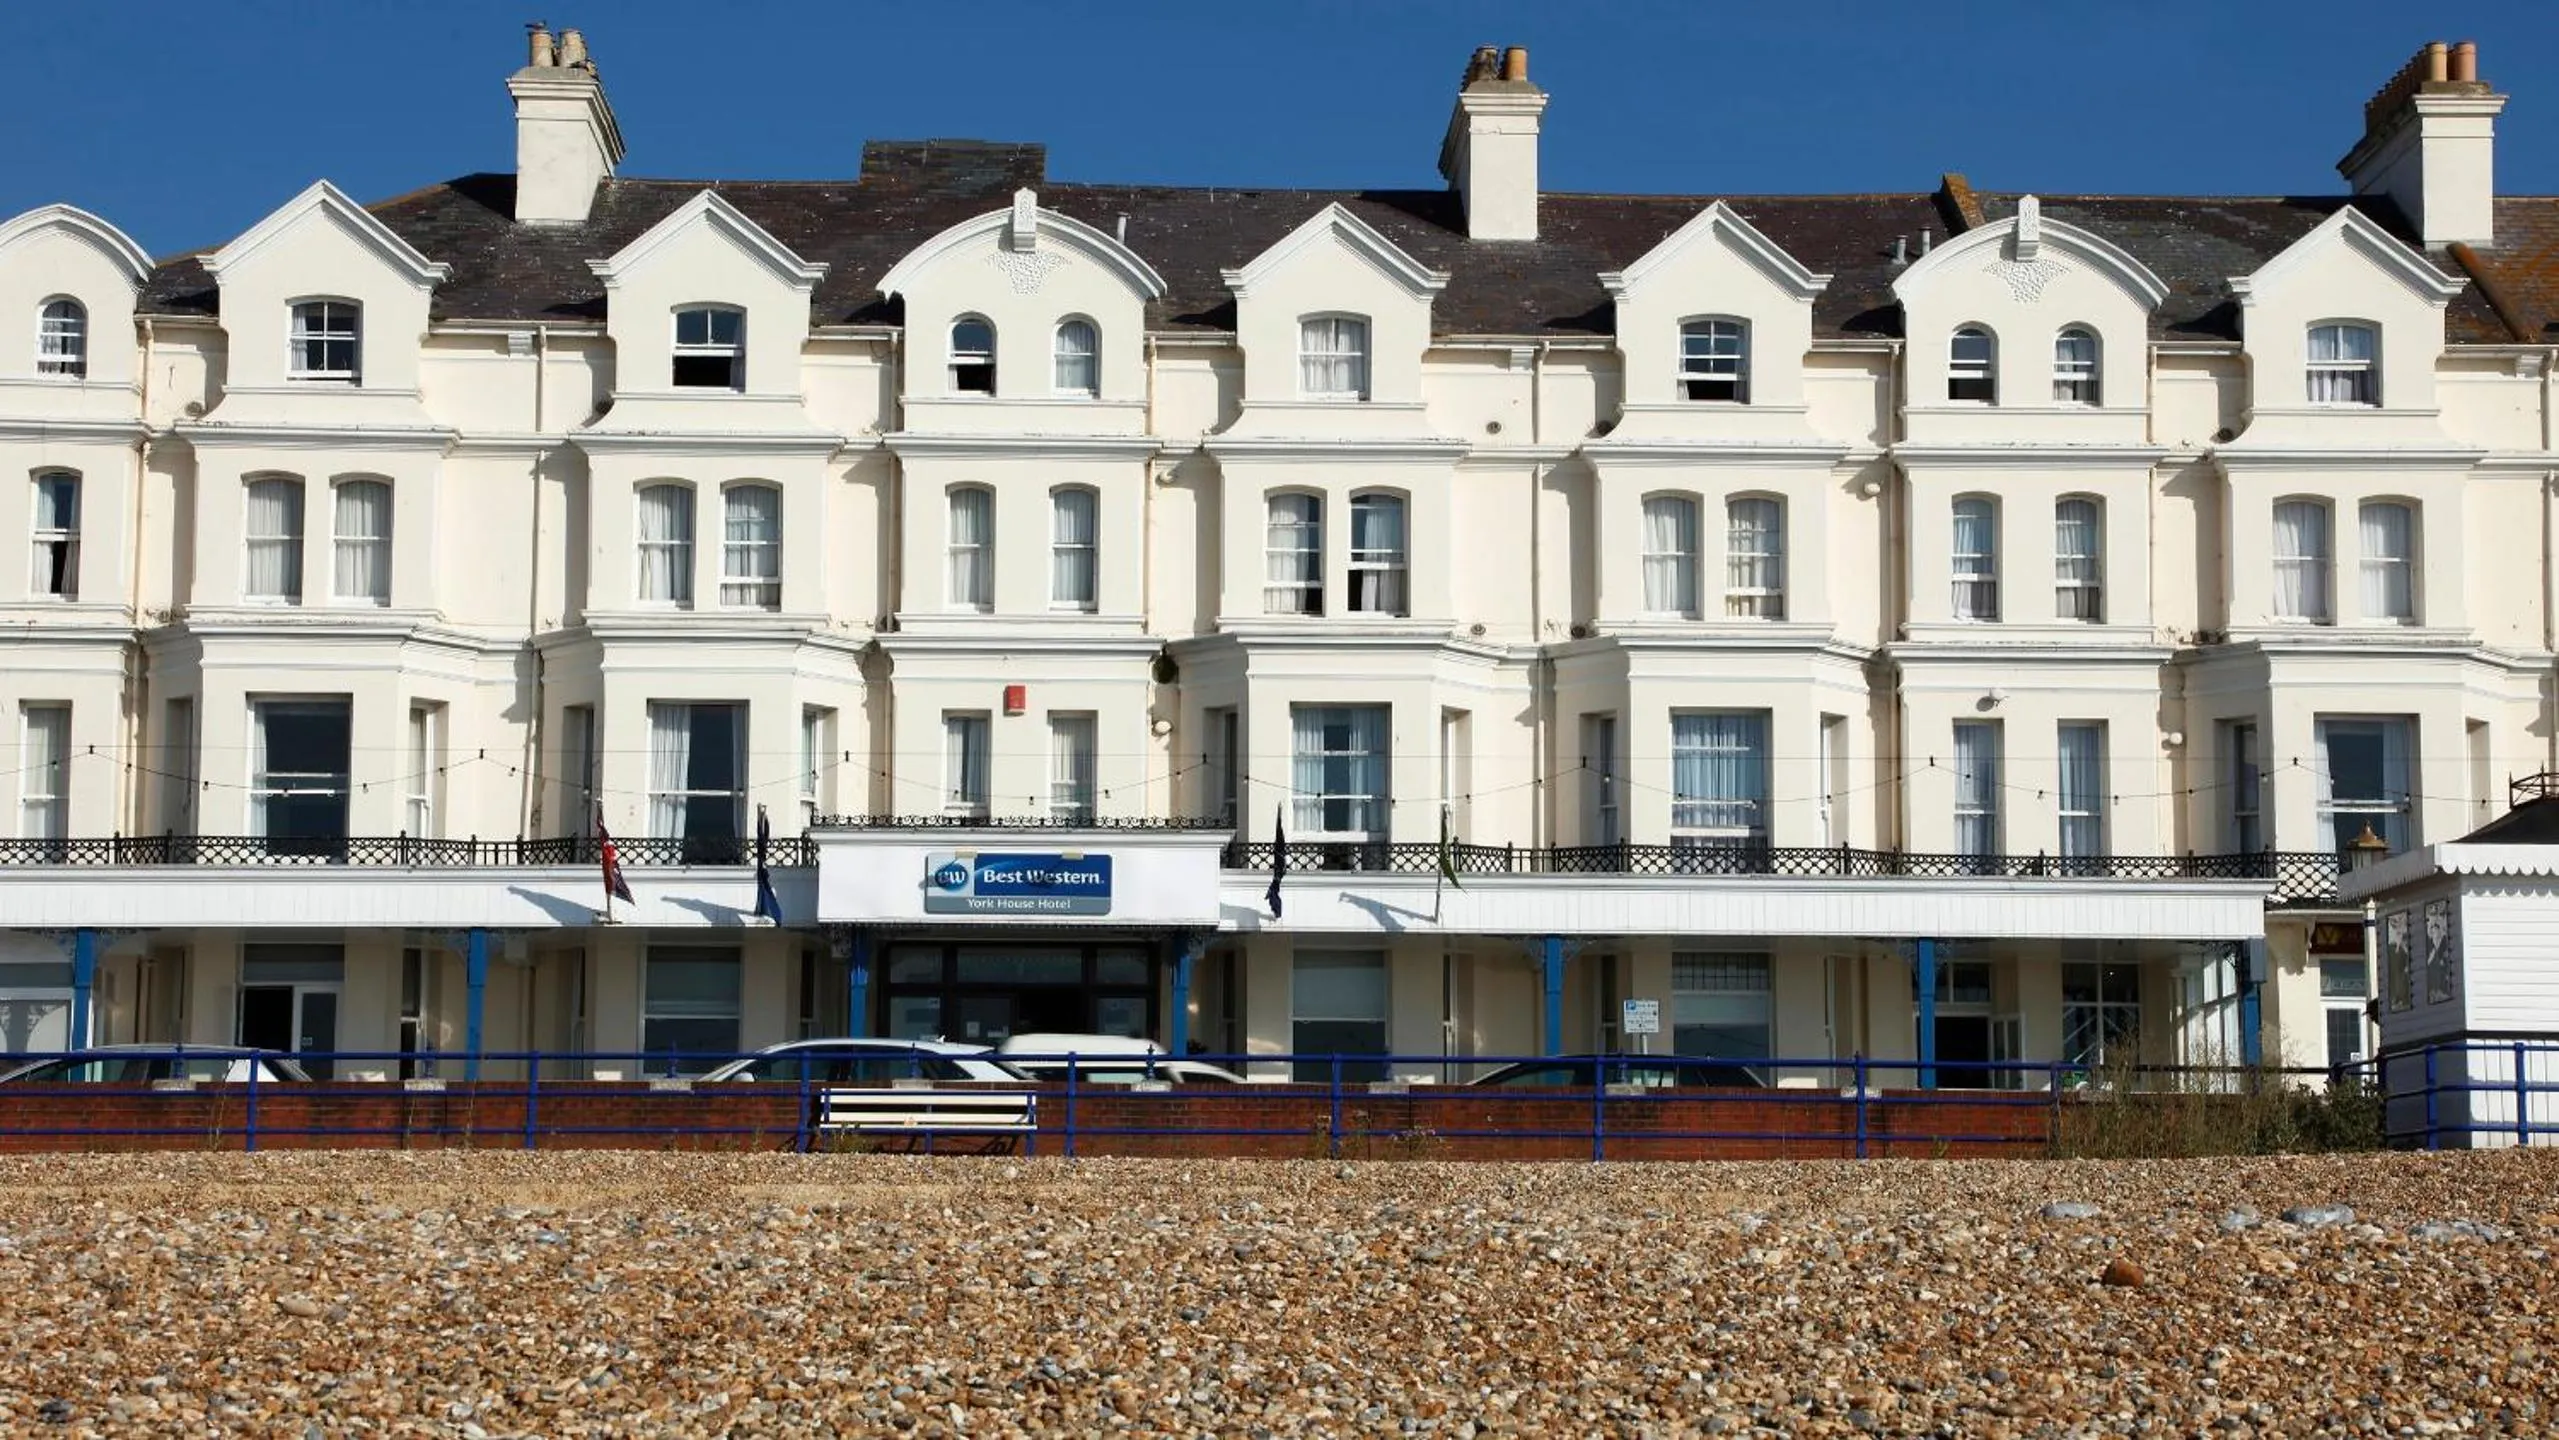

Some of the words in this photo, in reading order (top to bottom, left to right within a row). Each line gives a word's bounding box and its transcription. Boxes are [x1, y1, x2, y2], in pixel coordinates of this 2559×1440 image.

[983, 869, 1020, 883] Best
[967, 899, 994, 909] York
[998, 899, 1034, 909] House
[1038, 899, 1071, 909] Hotel
